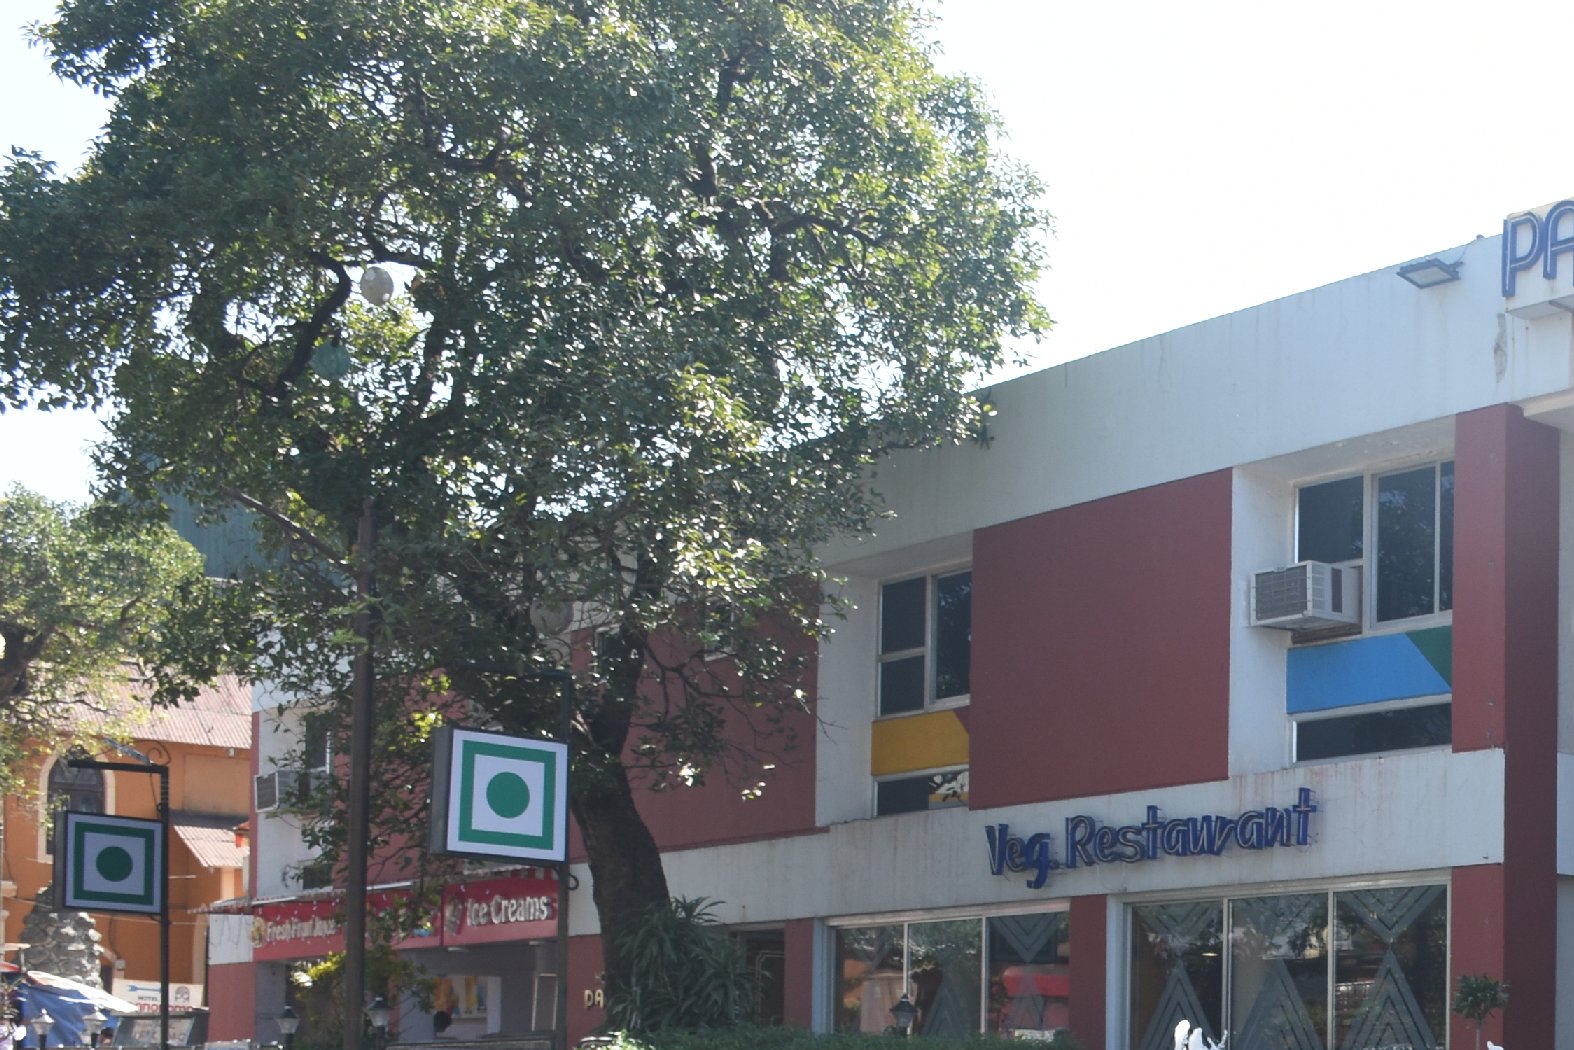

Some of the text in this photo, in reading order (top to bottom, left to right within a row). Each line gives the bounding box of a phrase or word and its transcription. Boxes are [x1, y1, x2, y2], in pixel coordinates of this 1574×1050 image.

[984, 787, 1318, 889] Veg. Restaurant
[465, 894, 549, 927] Ice Creams
